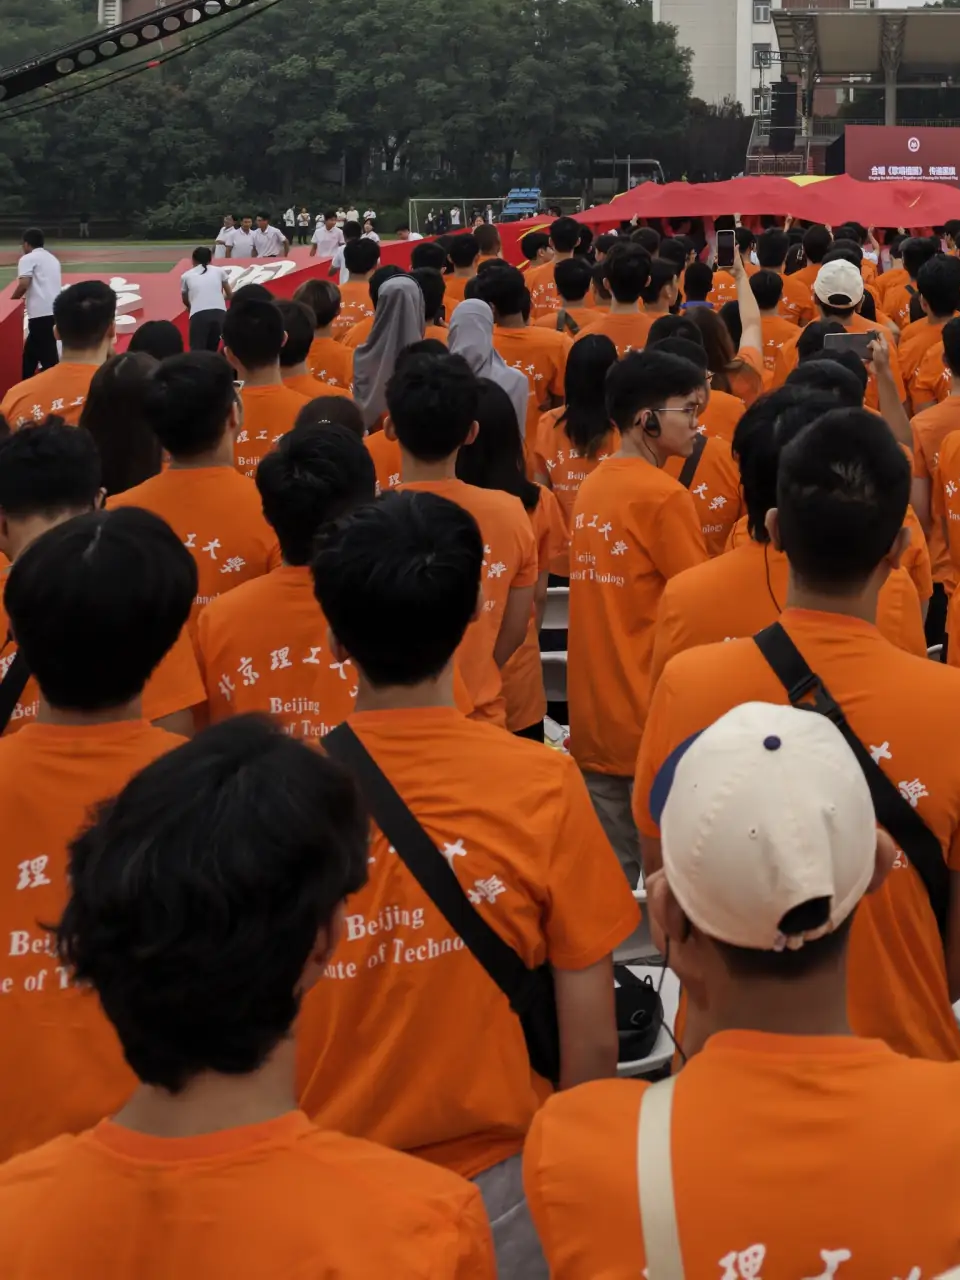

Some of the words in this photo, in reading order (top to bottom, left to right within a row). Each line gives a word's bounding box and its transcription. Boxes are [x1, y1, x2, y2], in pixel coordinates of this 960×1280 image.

[270, 697, 320, 715] Beijing
[345, 905, 425, 941] Beijing
[368, 943, 387, 968] of
[24, 969, 48, 991] of
